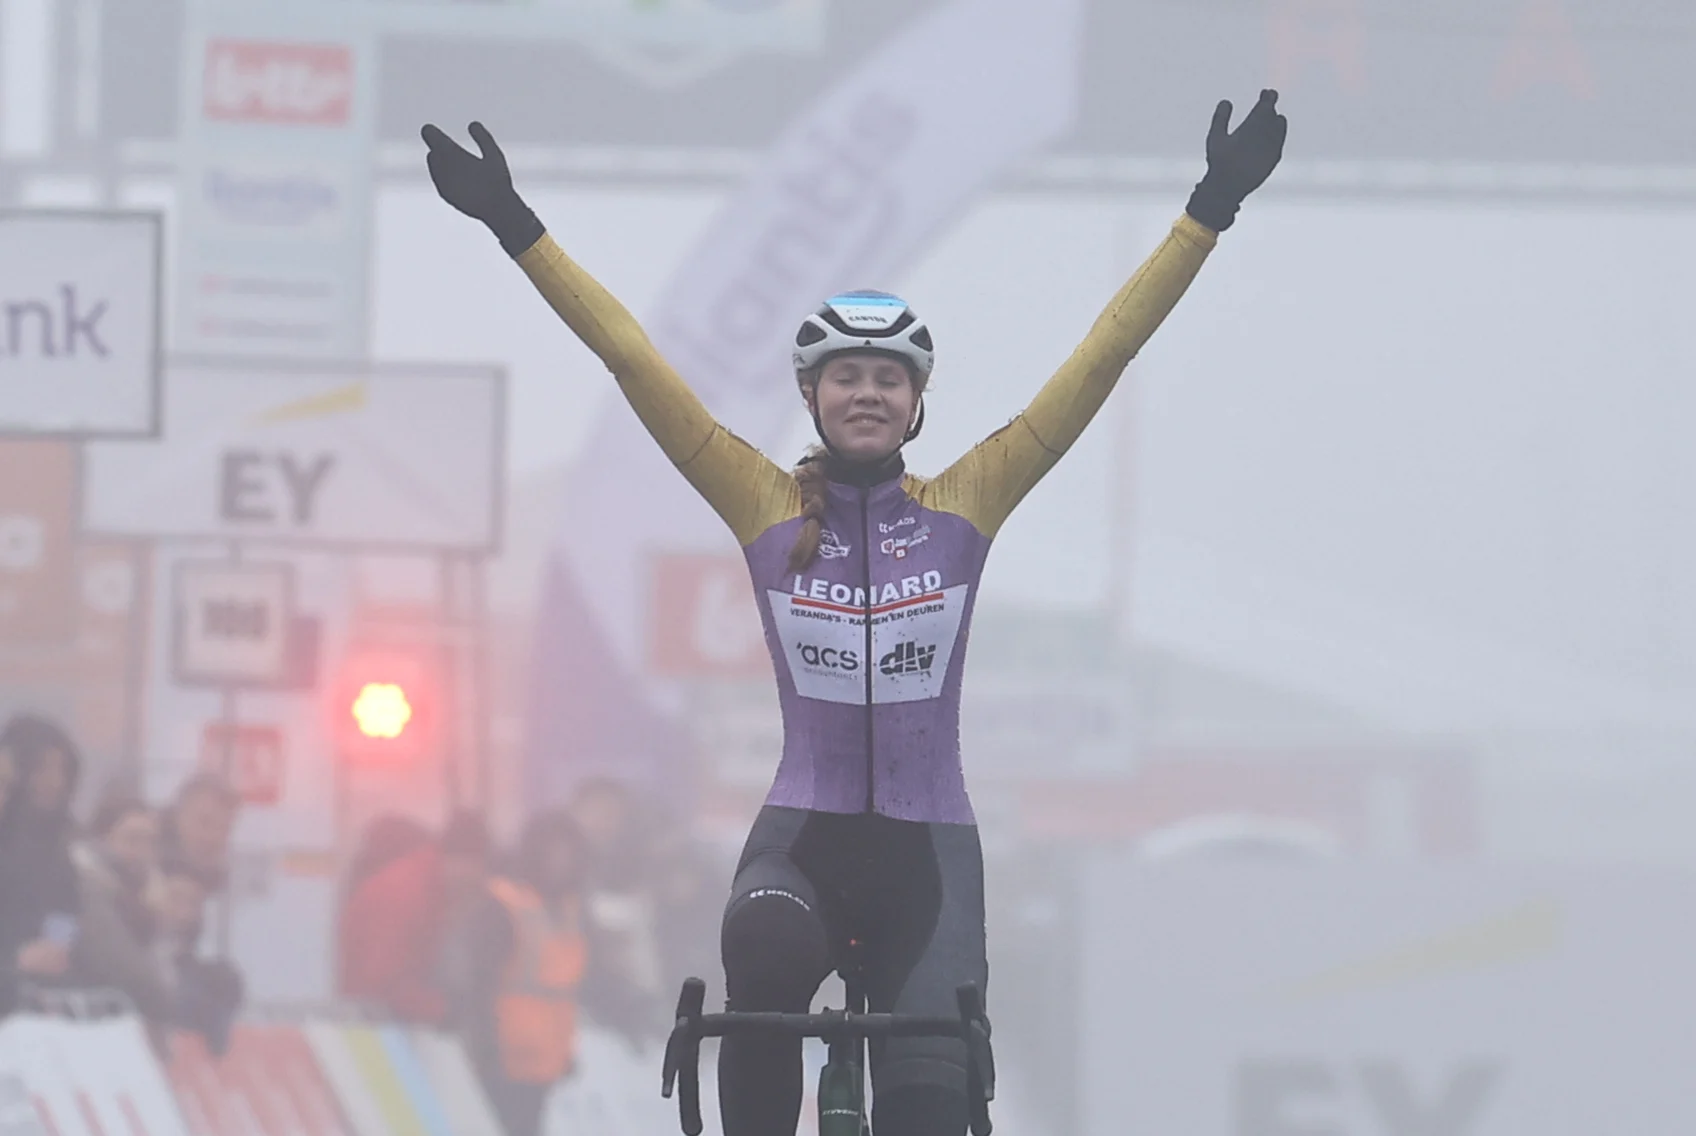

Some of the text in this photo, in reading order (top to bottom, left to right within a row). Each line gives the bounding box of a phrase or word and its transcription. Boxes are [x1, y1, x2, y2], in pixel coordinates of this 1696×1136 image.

[0, 283, 112, 359] nk
[217, 449, 339, 527] EY
[790, 608, 841, 624] VERANDA'S
[907, 603, 945, 618] DEUREN
[793, 570, 942, 607] LEONARD
